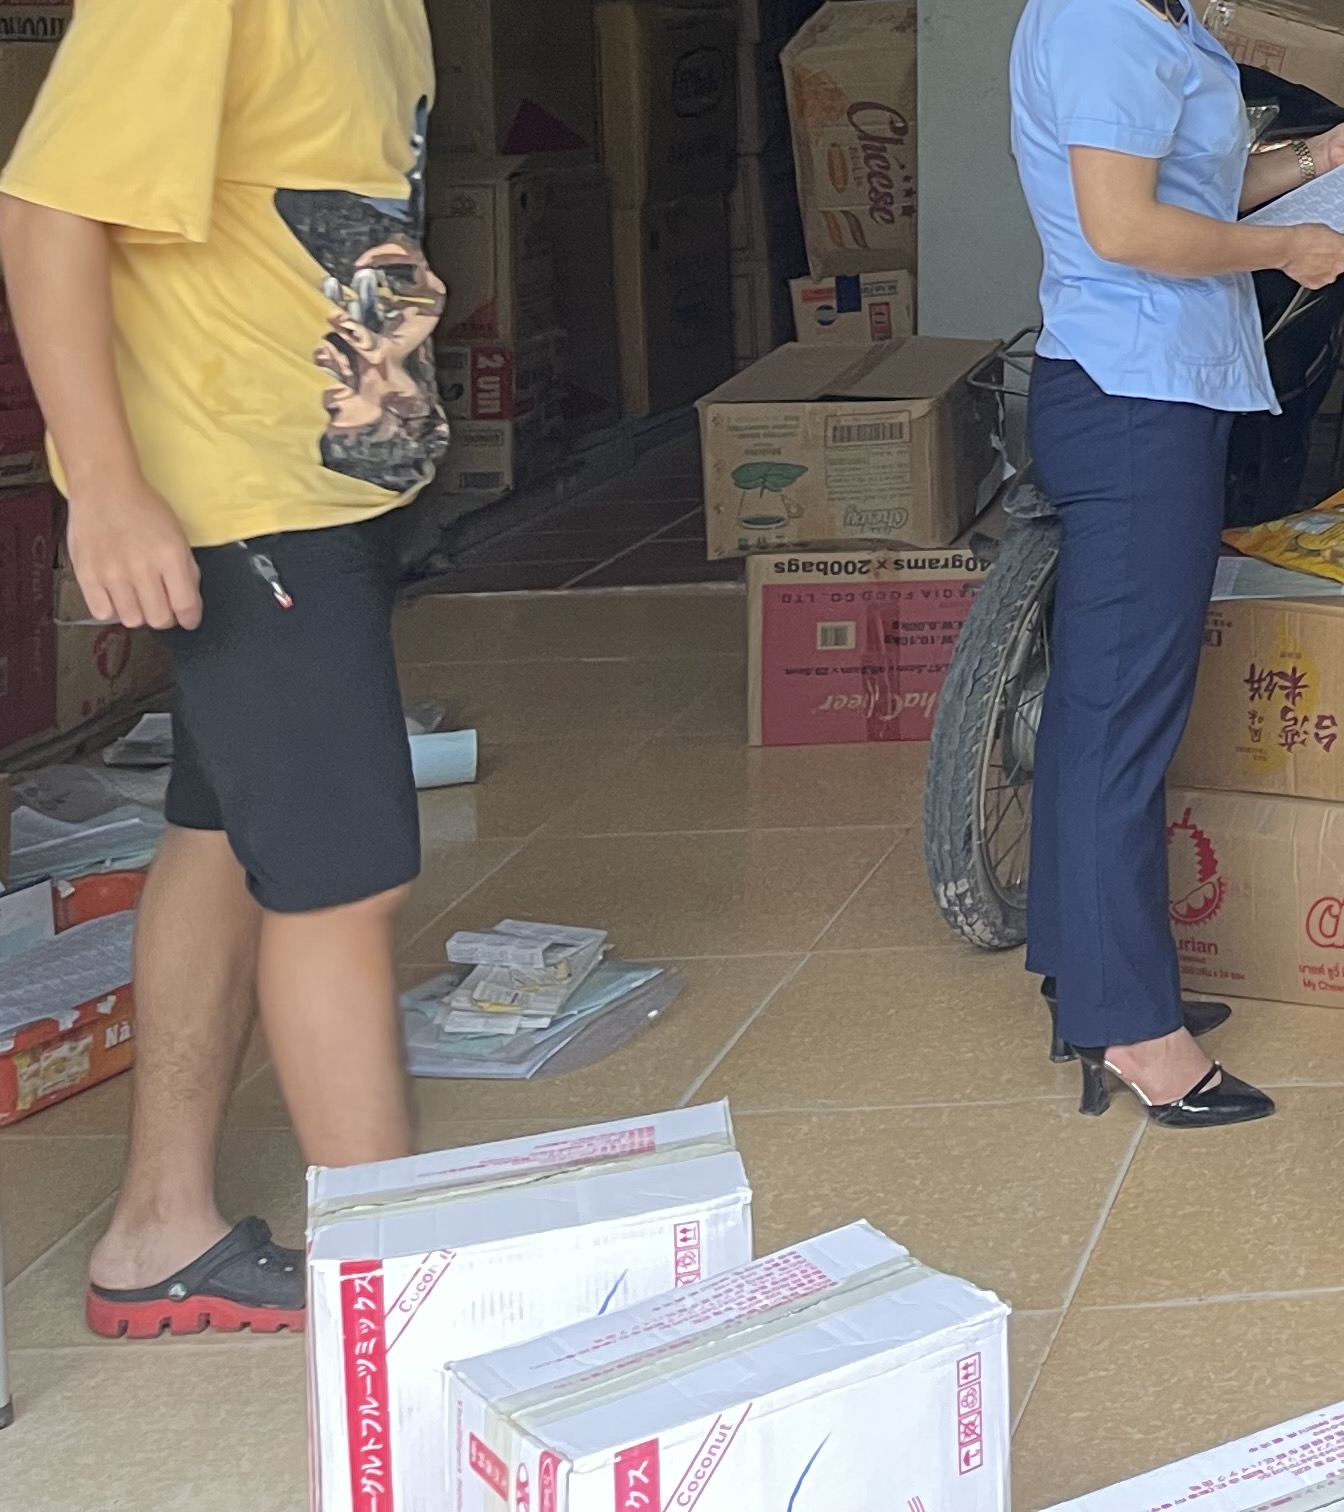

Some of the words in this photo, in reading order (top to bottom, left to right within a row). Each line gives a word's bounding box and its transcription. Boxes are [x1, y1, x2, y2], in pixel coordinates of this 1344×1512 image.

[846, 100, 910, 228] Cheese
[774, 557, 872, 575] 200bags
[675, 1421, 734, 1508] Coconut
